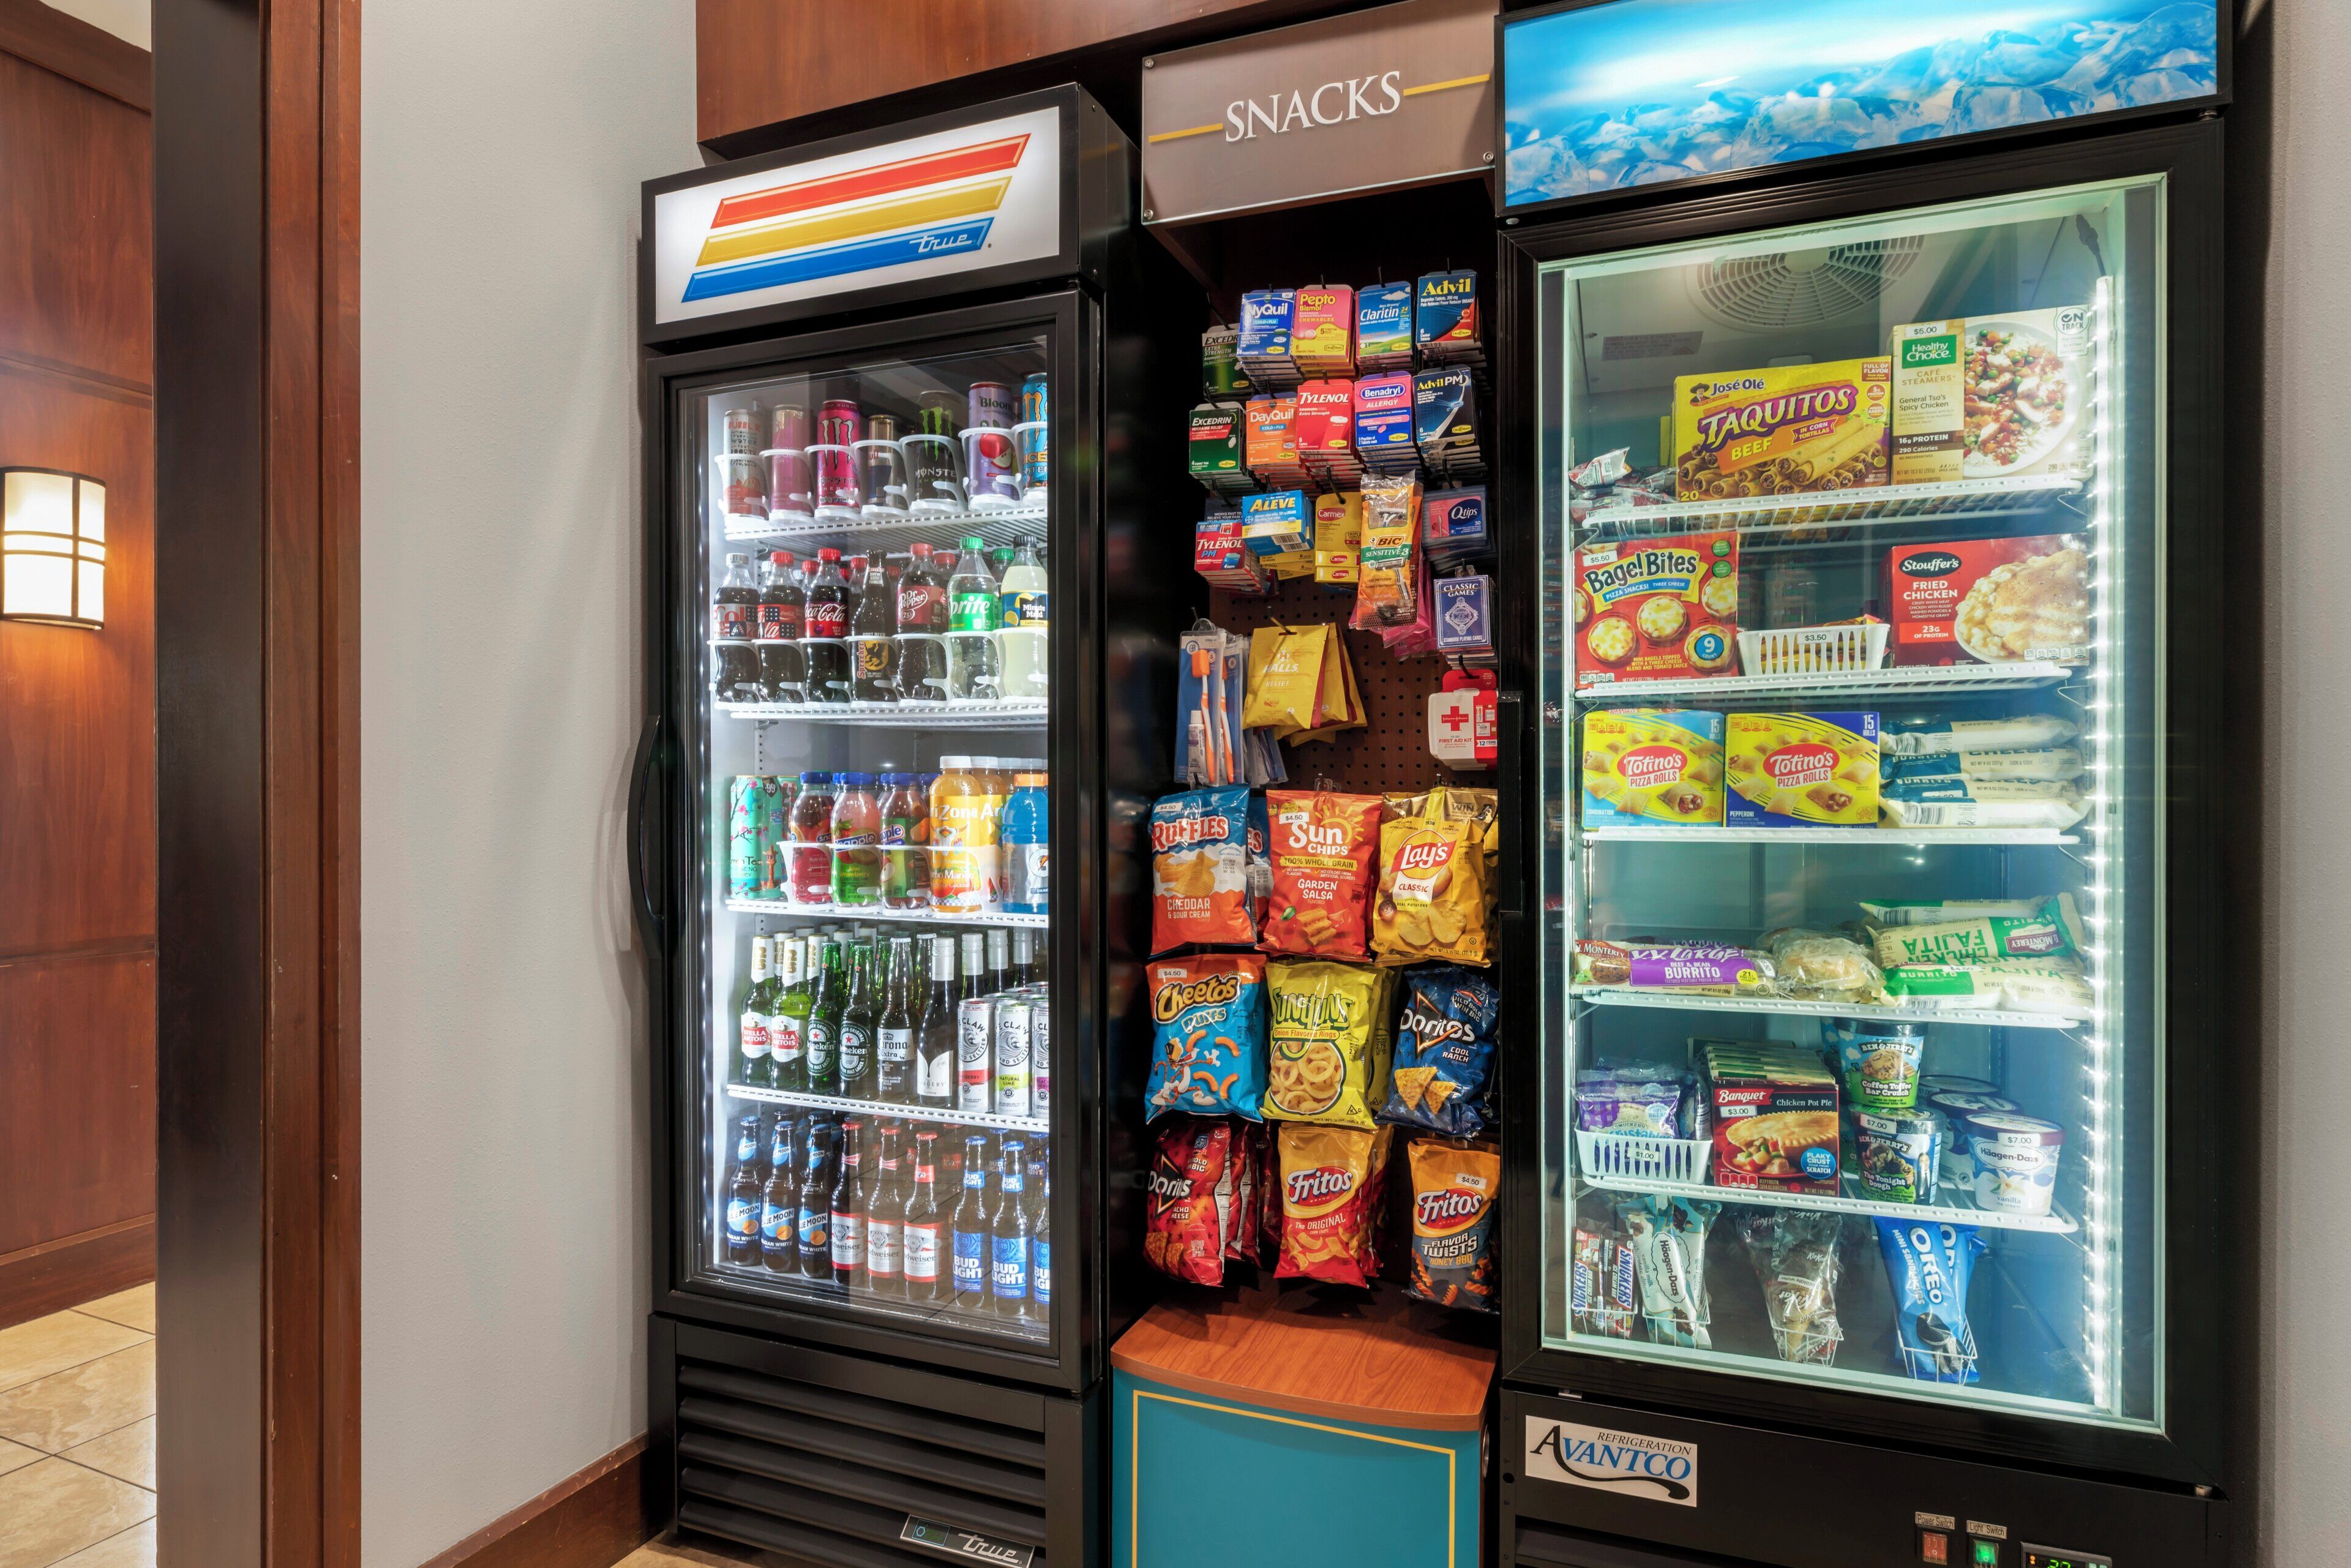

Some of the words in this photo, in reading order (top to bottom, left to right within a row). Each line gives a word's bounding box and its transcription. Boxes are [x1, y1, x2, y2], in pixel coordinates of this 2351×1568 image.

[1226, 70, 1400, 142] SNACKS
[1422, 278, 1471, 296] Advil
[1300, 294, 1336, 306] Pepto
[1360, 307, 1398, 321] Claritin
[1914, 326, 1937, 335] $5.00
[2062, 321, 2083, 331] TRACK
[1913, 343, 1948, 352] Healthy
[1907, 351, 1949, 362] Choice
[1417, 378, 1444, 391] Advil
[1445, 376, 1463, 385] PM
[1711, 380, 1740, 396] José
[1742, 378, 1764, 390] Olé
[1902, 376, 1952, 385] STEAMERS
[1299, 392, 1349, 404] TYLENOL
[1365, 387, 1401, 397] Benadryl
[1366, 399, 1398, 408] ALLERGY
[1192, 417, 1232, 426] EXCEDRIN
[1250, 409, 1294, 424] DayQuil
[1701, 389, 1852, 449] TAQUITOS
[1810, 422, 1828, 430] CORN
[1732, 438, 1772, 460] BEEF
[1250, 498, 1295, 512] ALEVE
[1198, 539, 1242, 550] TYLENOL
[1903, 558, 1959, 571] Stouffer's
[1585, 552, 1644, 594] Bagel
[1646, 552, 1697, 576] Bites
[1913, 580, 1948, 590] FRIED
[1903, 589, 1957, 600] CHICKEN
[1704, 637, 1715, 653] 9
[1263, 664, 1298, 673] HALLS
[1624, 754, 1682, 775] Totino's
[1770, 751, 1834, 775] Totino's
[1630, 776, 1651, 787] PIZZA
[1654, 771, 1677, 783] ROLLS
[1778, 776, 1800, 787] PIZZA
[1804, 771, 1828, 783] ROLLS
[1152, 817, 1228, 850] RUFFLES
[1289, 822, 1343, 848] Sun
[1308, 844, 1348, 855] CHIPS
[1401, 841, 1448, 870] Lay's
[1298, 879, 1338, 889] GARDEN
[1398, 883, 1428, 892] CLASSIC
[1303, 890, 1332, 900] SALSA
[1167, 899, 1210, 910] CHEDDAR
[1902, 929, 1985, 955] FAJITA
[1665, 967, 1720, 979] BURRITO
[1158, 977, 1239, 1020] Cheetos
[962, 1018, 985, 1032] CLAW
[1442, 1052, 1469, 1062] RANCH
[1450, 1047, 1469, 1056] COOL
[1719, 1090, 1766, 1103] Banquet
[1981, 1147, 2038, 1163] Häagen-Dazs
[1288, 1168, 1352, 1202] Fritos
[1462, 1177, 1479, 1185] $4.50
[740, 1204, 760, 1217] MOON
[1417, 1190, 1483, 1223] Fritos
[773, 1210, 793, 1221] MOON
[806, 1215, 827, 1228] MOON
[1307, 1214, 1346, 1229] ORIGINAL
[1456, 1254, 1472, 1265] BBQ
[1909, 1227, 1942, 1304] OREO
[1660, 1240, 1678, 1296] Häagen-Dazs
[1617, 1250, 1632, 1309] SNICKERS
[1597, 1433, 1691, 1455] REFRIGERATION
[1530, 1425, 1690, 1480] AVANTCO
[1918, 1514, 1934, 1525] Power
[1936, 1518, 1954, 1528] Switch
[1970, 1521, 1984, 1534] Light
[1987, 1526, 2004, 1536] Switch
